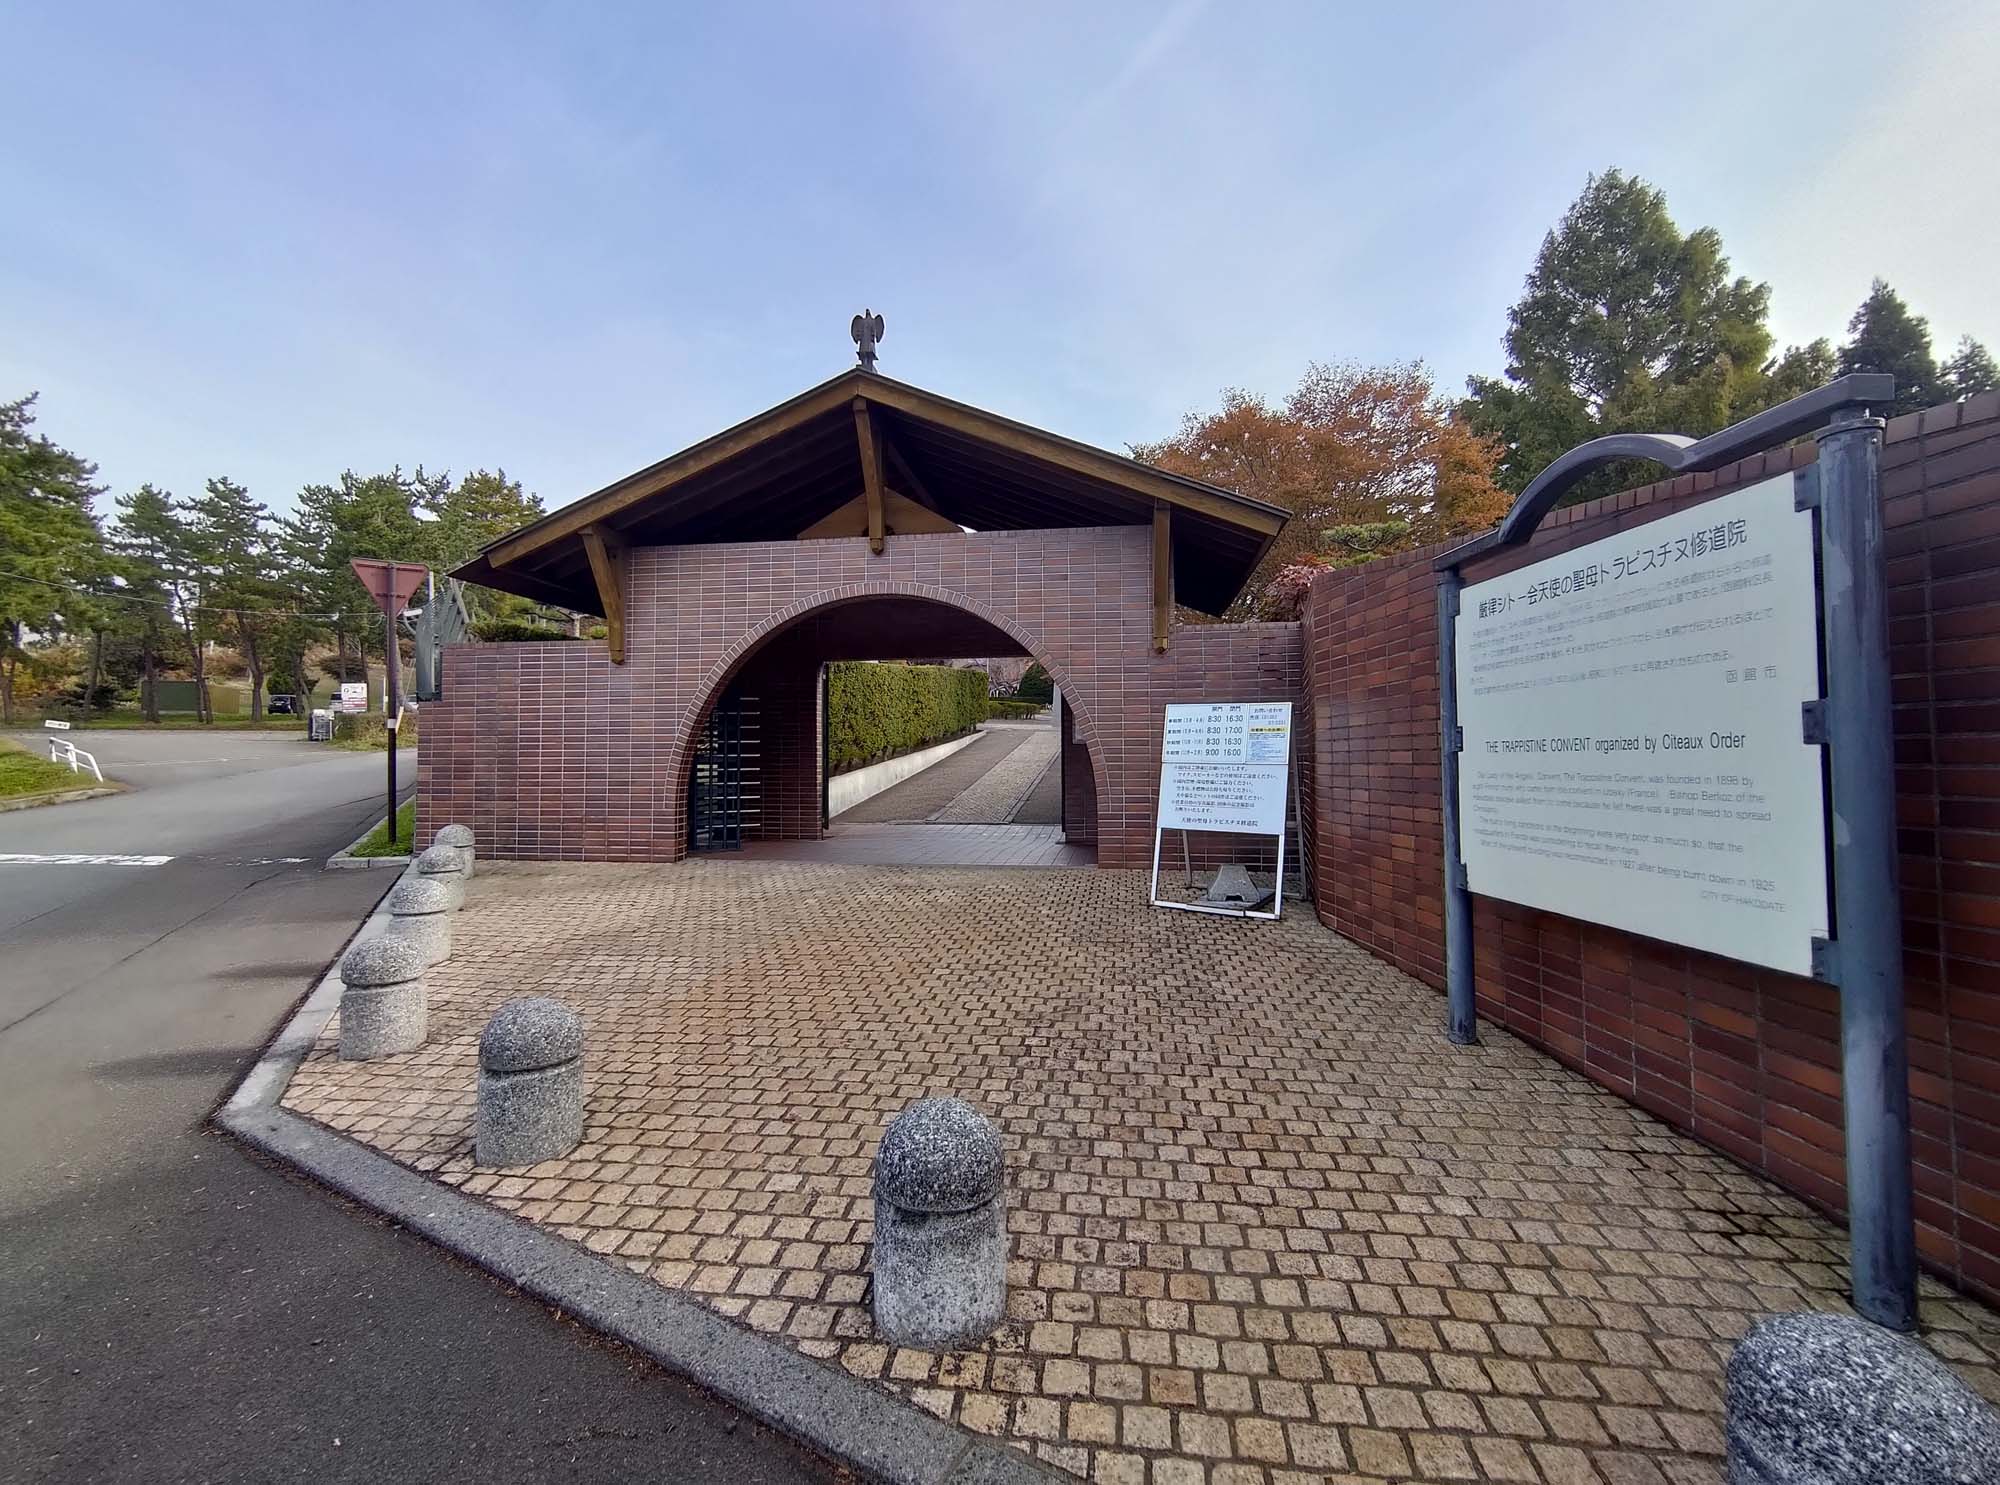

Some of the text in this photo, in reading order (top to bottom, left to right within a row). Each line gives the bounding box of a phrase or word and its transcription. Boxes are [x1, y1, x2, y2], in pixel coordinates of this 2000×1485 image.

[1208, 715, 1222, 723] 8:30
[1207, 726, 1220, 734] 8:30
[1225, 726, 1242, 734] 17:00
[1485, 731, 1746, 754] THE TRAPPISTINE CONVENT organized by Citeaux Order
[1205, 748, 1219, 756] 9:00
[1223, 748, 1241, 756] 16:00
